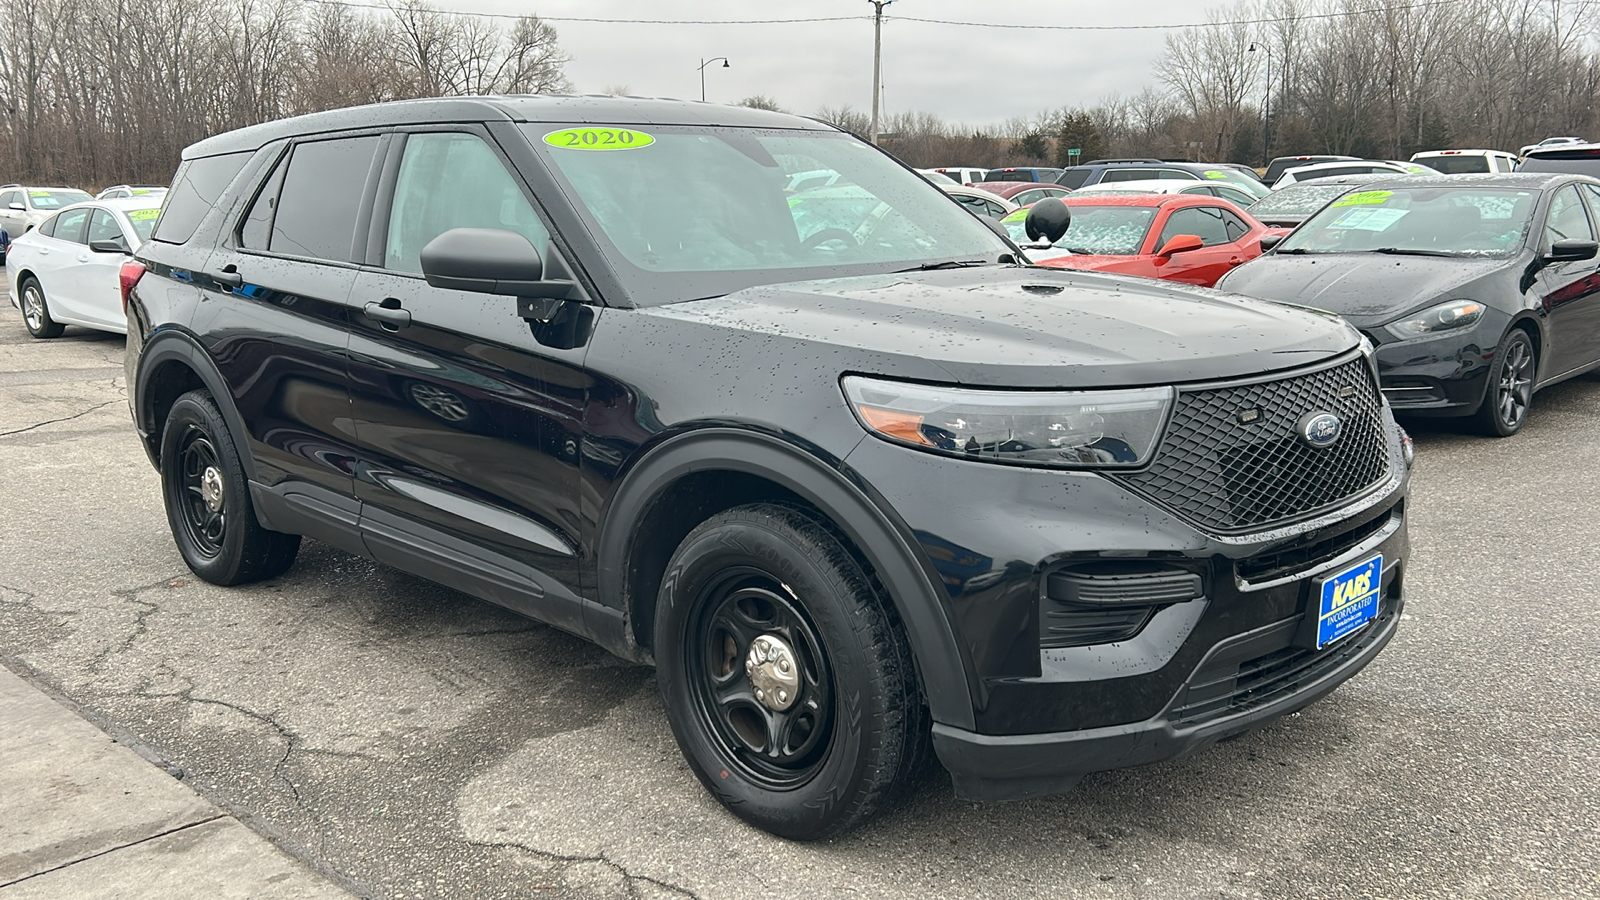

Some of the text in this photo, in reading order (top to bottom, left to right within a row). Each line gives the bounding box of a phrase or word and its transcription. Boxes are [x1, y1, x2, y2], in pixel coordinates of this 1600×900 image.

[564, 131, 634, 146] 2020
[1317, 420, 1336, 438] Ford
[1331, 570, 1372, 610] KARS
[1327, 596, 1372, 626] INCORPORATED
